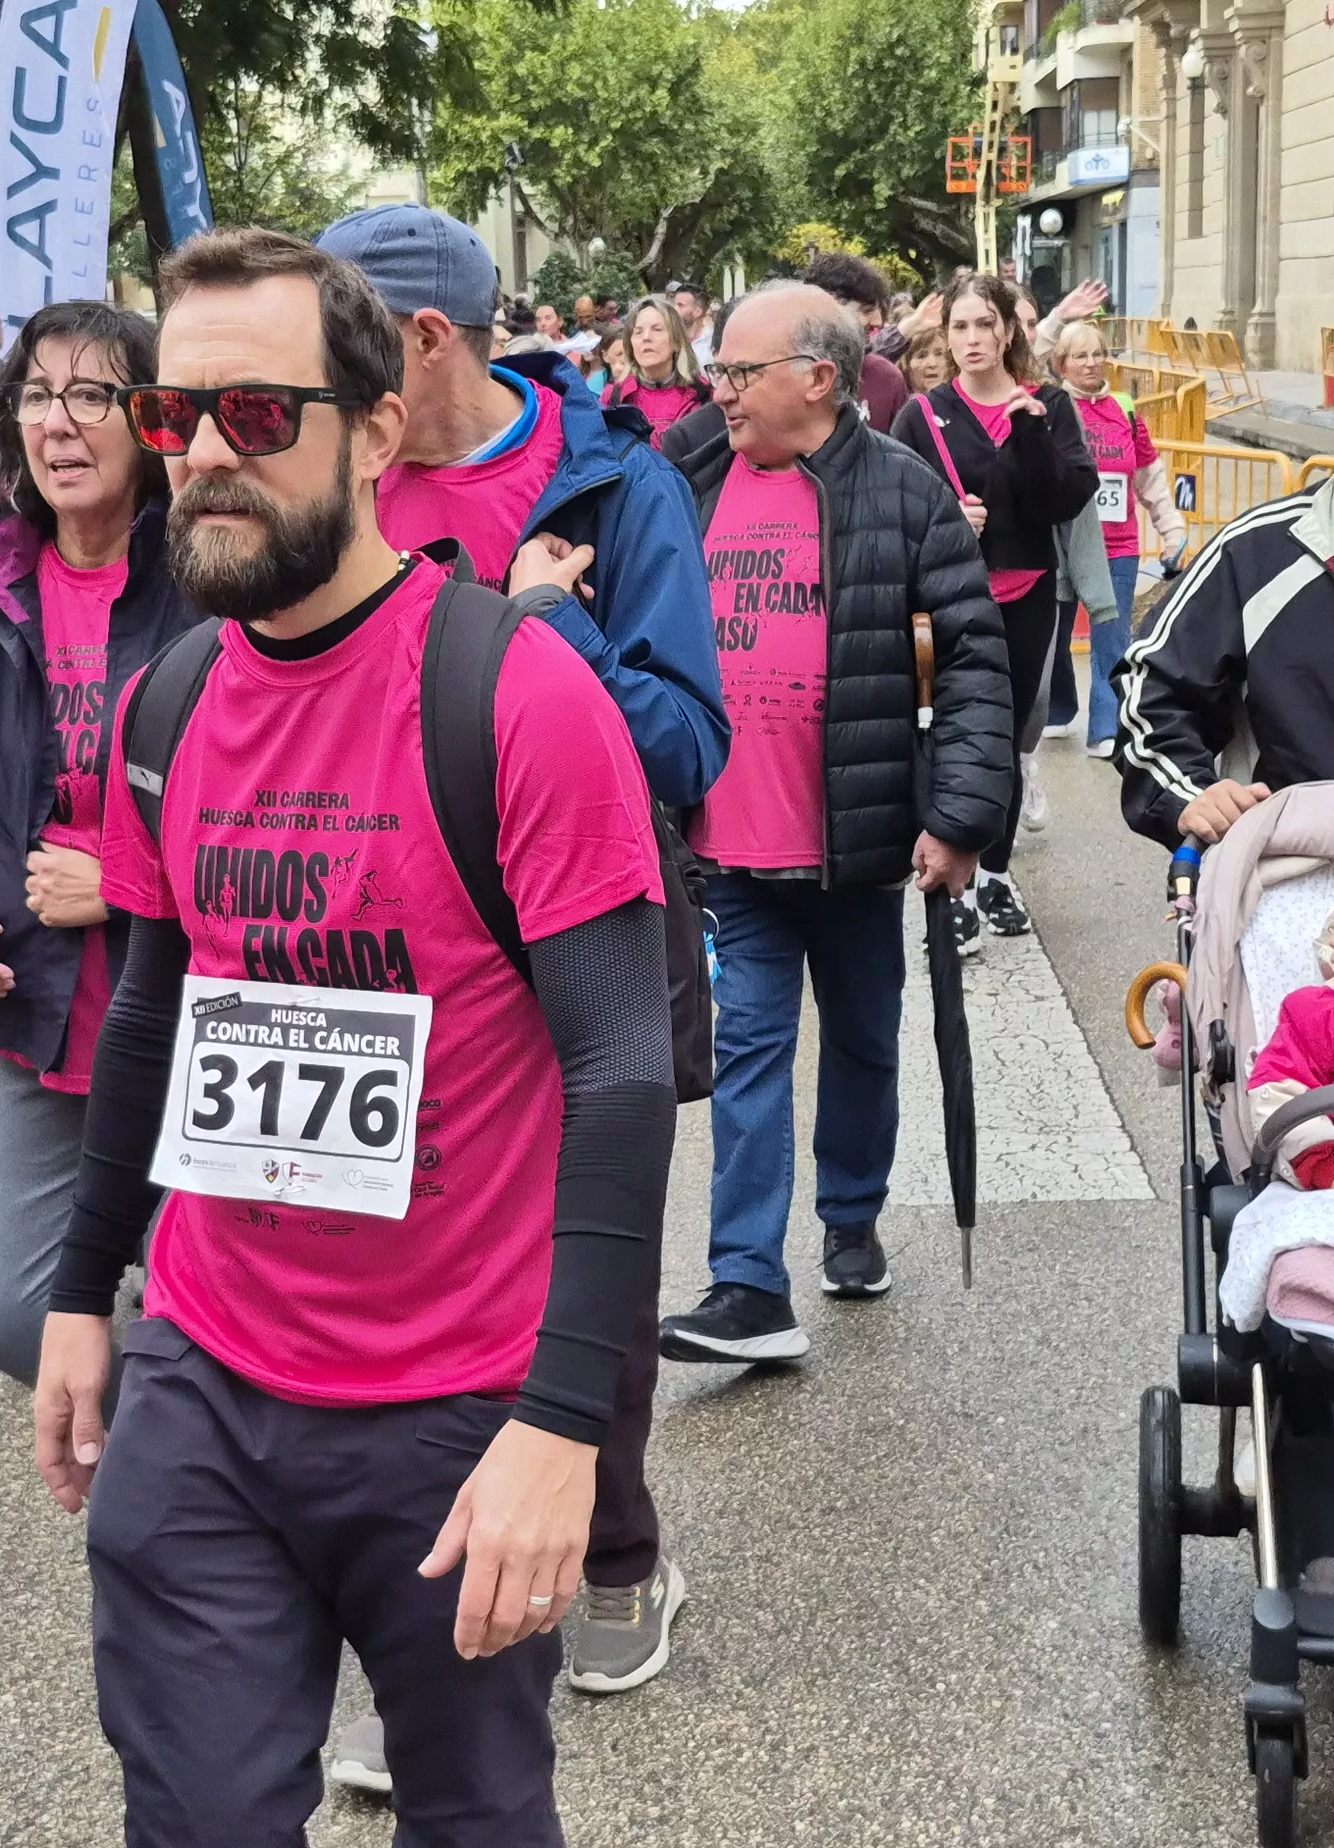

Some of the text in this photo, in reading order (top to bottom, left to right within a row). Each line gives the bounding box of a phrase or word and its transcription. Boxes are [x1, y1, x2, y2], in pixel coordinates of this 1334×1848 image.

[747, 532, 780, 541] CONTRA
[758, 522, 798, 531] CARRERA
[733, 582, 822, 617] EN CADA
[255, 790, 350, 809] XII CARRERA
[198, 808, 255, 828] HUESCA
[259, 813, 319, 831] CONTRA
[323, 815, 339, 832] EL
[194, 844, 330, 923] UNIDOS
[194, 996, 240, 1016] XII EDICIÓN
[270, 1008, 327, 1028] HUESCA
[206, 1021, 401, 1056] CONTRA EL CÁNCER
[192, 1054, 400, 1148] 3176
